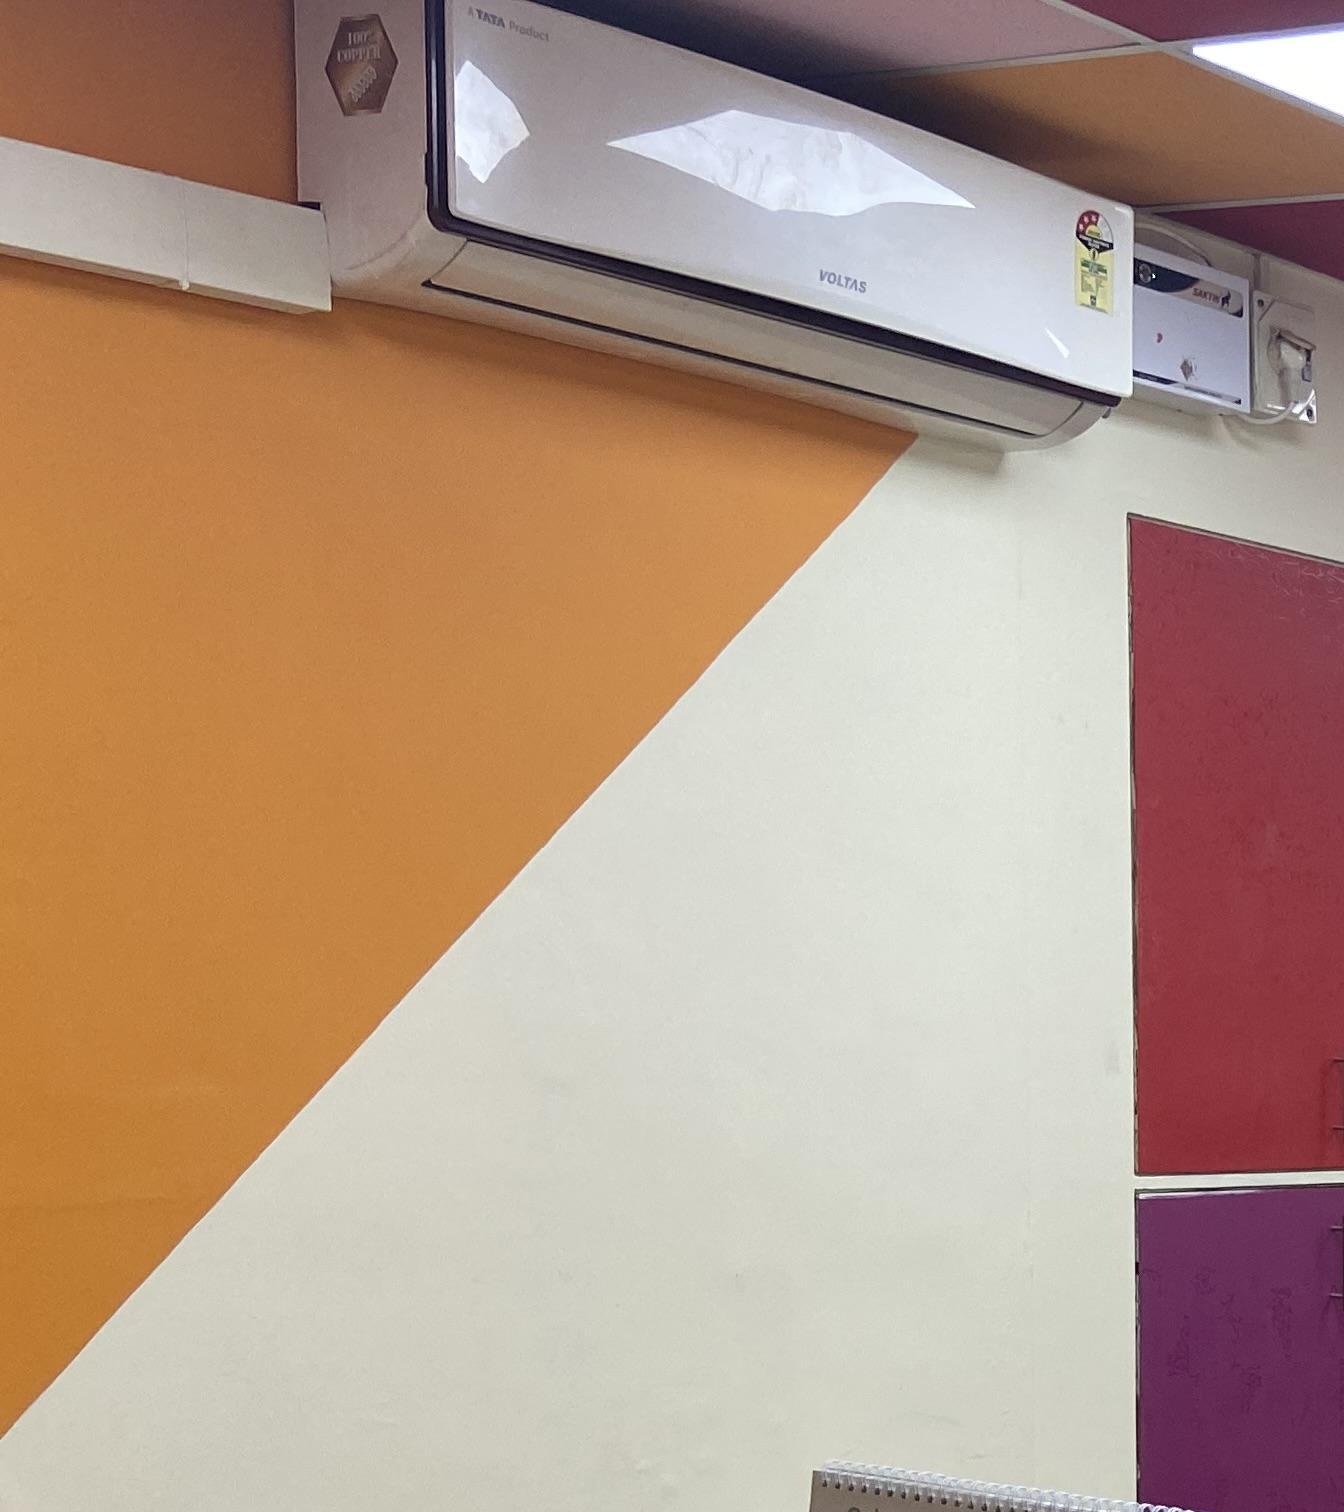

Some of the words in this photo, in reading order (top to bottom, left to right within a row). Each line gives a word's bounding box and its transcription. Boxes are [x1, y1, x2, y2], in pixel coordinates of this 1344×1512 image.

[476, 8, 506, 29] TATA
[509, 19, 550, 41] Product
[819, 268, 868, 294] VOLTAS
